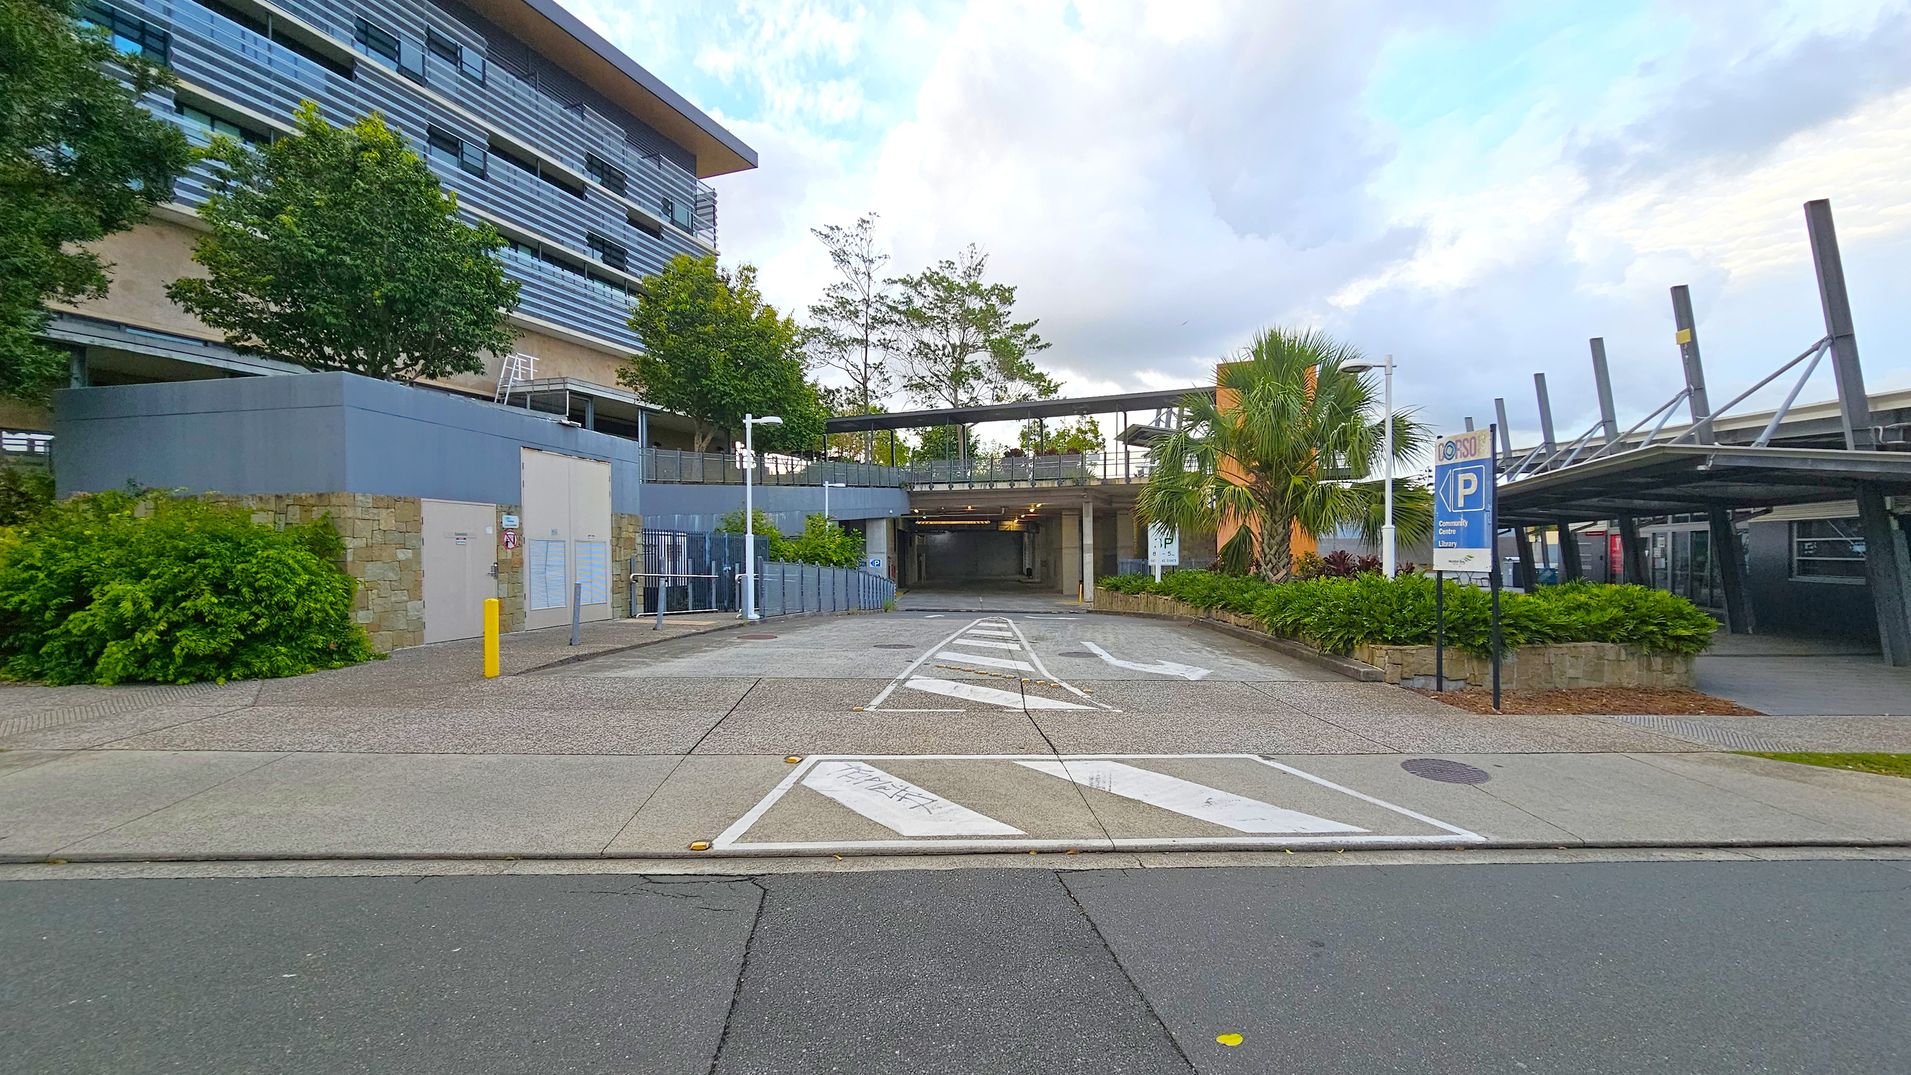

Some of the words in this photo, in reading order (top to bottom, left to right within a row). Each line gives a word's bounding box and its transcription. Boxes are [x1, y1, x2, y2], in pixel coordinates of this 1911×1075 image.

[1438, 436, 1477, 461] CORSO
[1457, 472, 1478, 507] P
[1438, 518, 1468, 527] Community
[1438, 540, 1457, 549] Library
